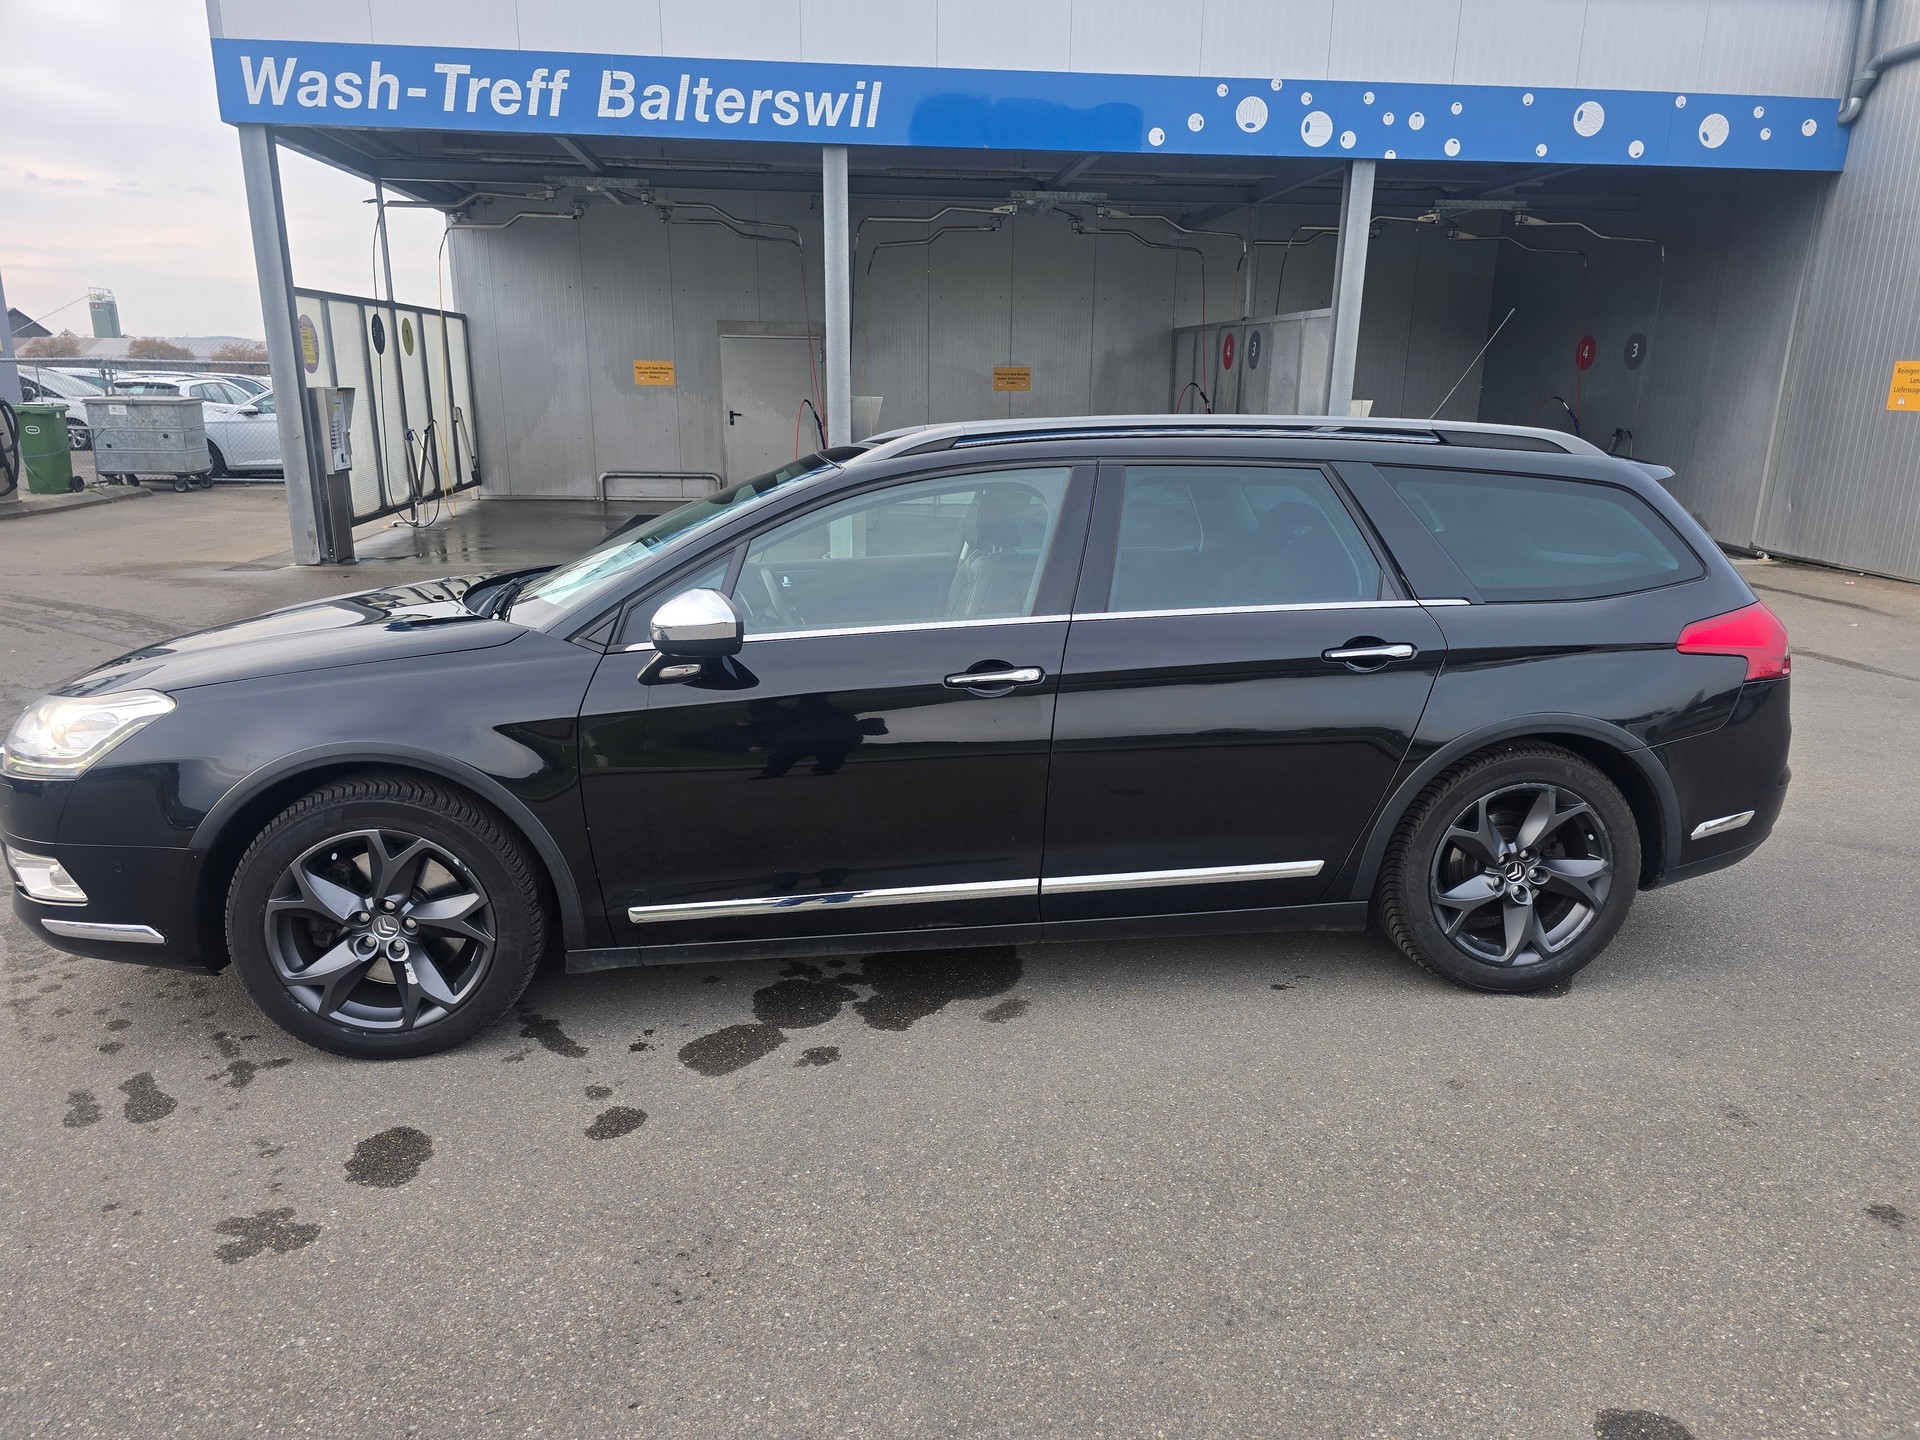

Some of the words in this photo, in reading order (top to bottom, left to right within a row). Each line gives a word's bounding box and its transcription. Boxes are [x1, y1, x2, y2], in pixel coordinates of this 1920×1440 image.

[240, 55, 571, 118] Wash-Treff
[596, 69, 883, 129] Balterswil
[1251, 342, 1257, 357] 3
[1582, 345, 1589, 359] 4
[1631, 343, 1639, 357] 3
